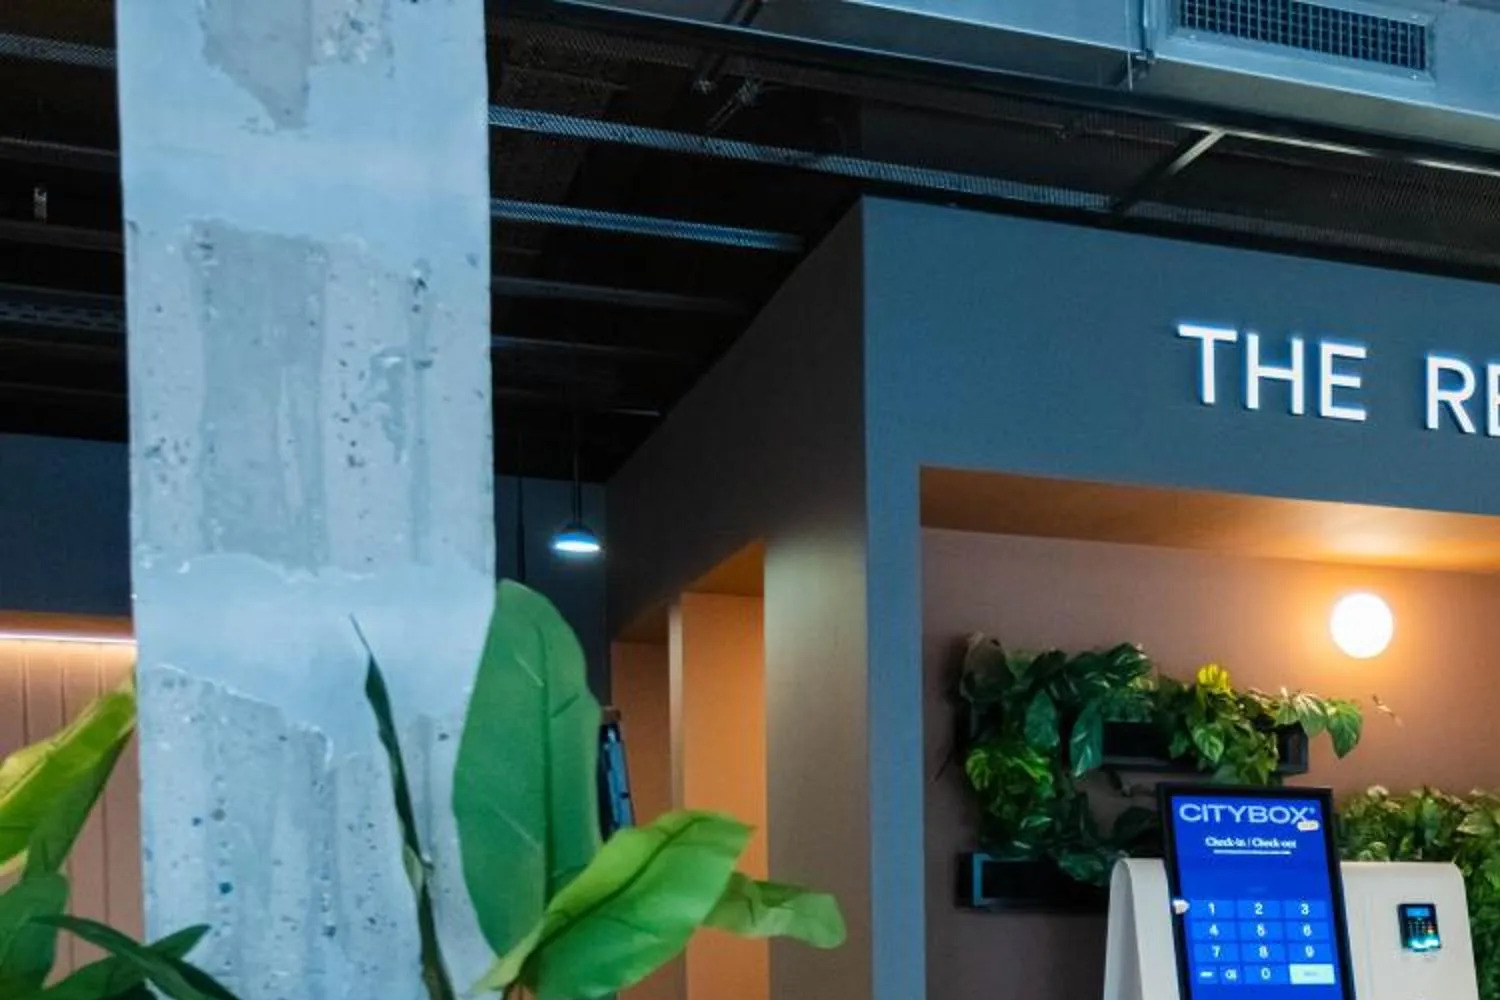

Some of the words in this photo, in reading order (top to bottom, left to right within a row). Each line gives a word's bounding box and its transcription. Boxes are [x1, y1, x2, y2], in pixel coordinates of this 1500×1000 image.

[1177, 323, 1367, 422] THE
[1179, 803, 1308, 825] CITYBOX
[1208, 902, 1216, 916] 1
[1254, 902, 1264, 916] 2
[1300, 902, 1310, 916] 3
[1208, 923, 1219, 937] 4
[1256, 923, 1266, 937] 5
[1303, 923, 1312, 937] 6
[1211, 945, 1221, 958] 7
[1259, 945, 1269, 959] 8
[1305, 945, 1315, 958] 9
[1260, 967, 1271, 980] 0
